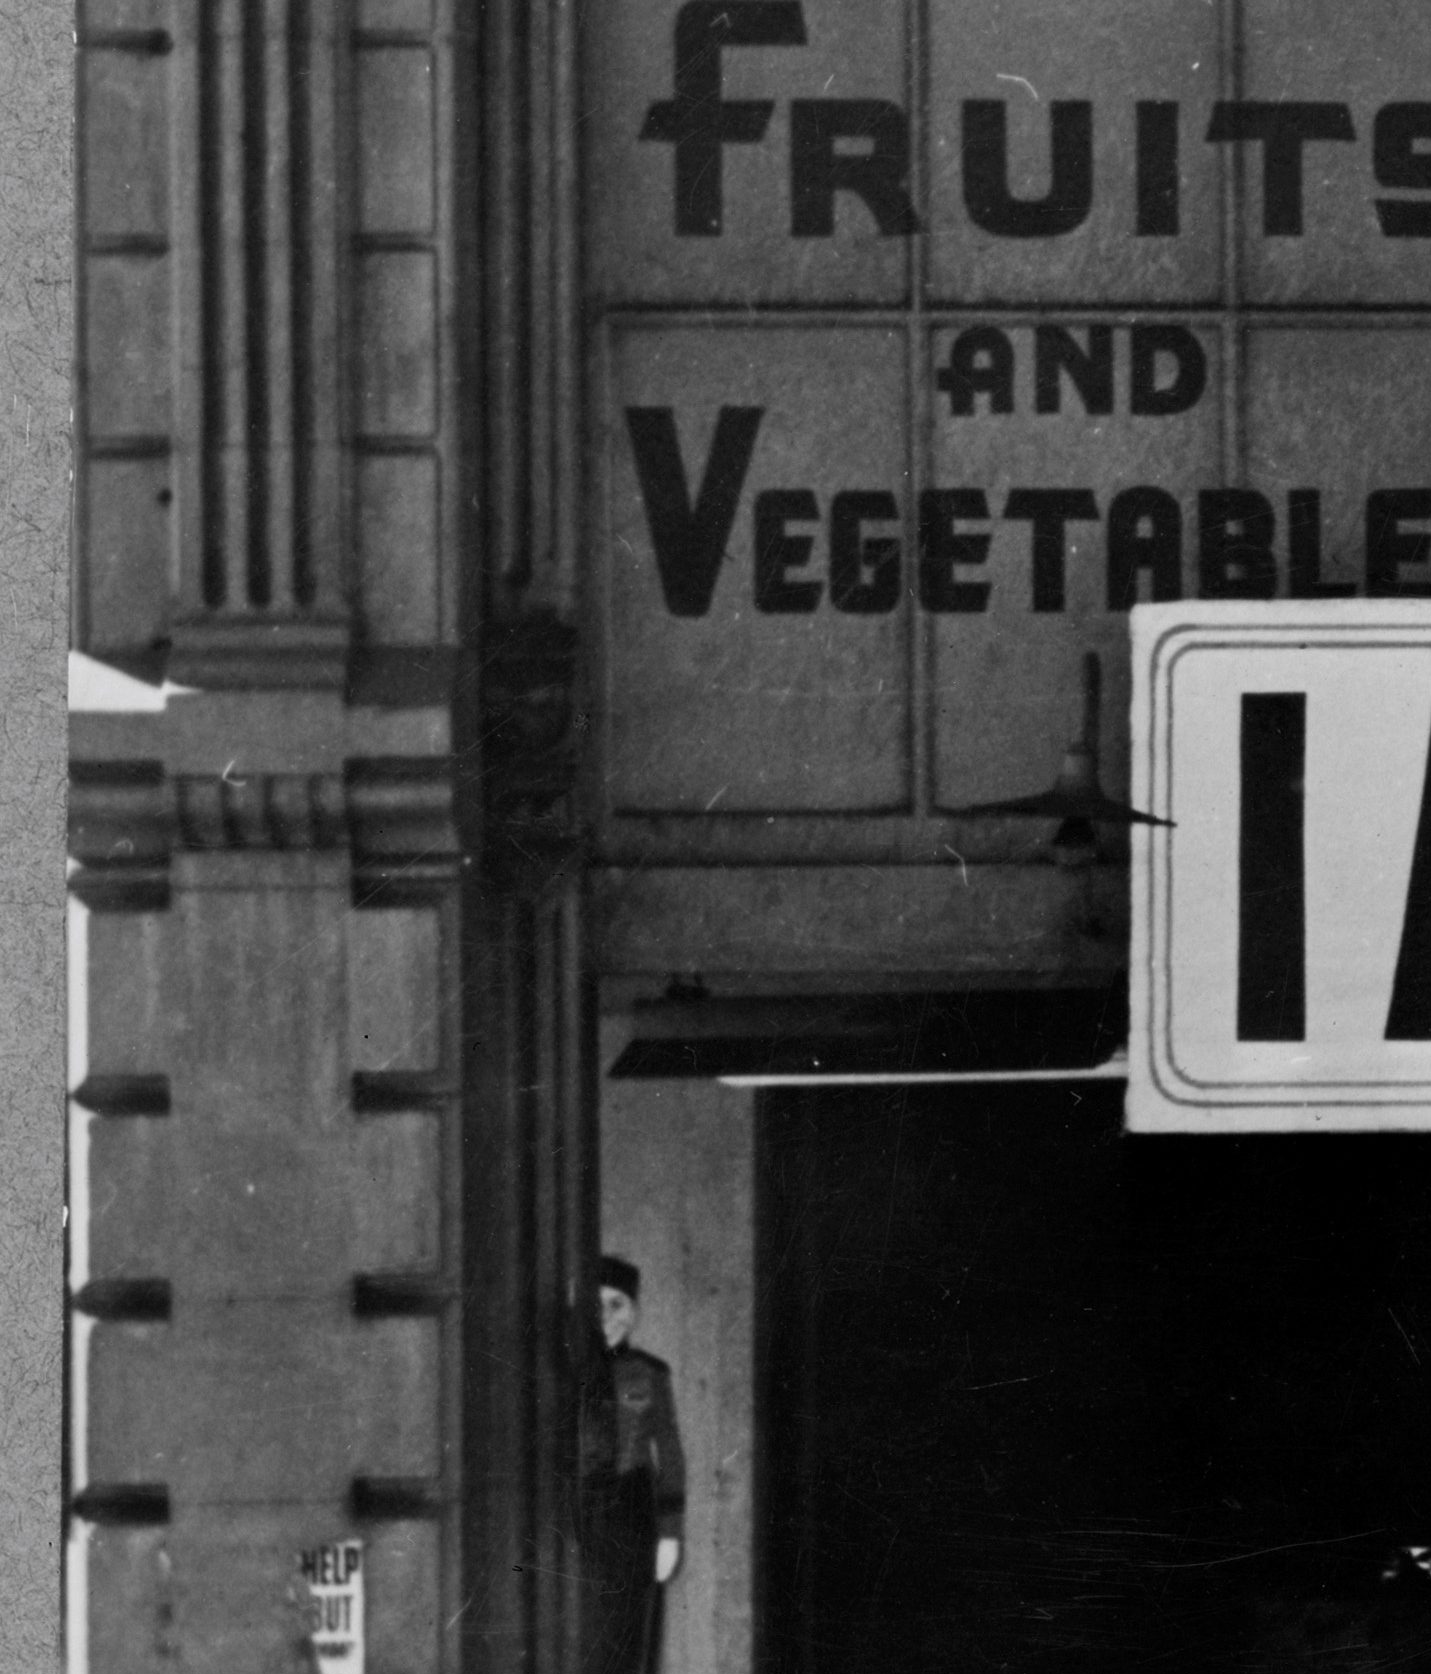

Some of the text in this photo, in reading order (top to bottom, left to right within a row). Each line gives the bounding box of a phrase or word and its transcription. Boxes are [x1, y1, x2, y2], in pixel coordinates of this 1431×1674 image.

[937, 324, 1207, 416] AND
[1236, 692, 1306, 1043] I
[301, 1546, 360, 1585] HELP
